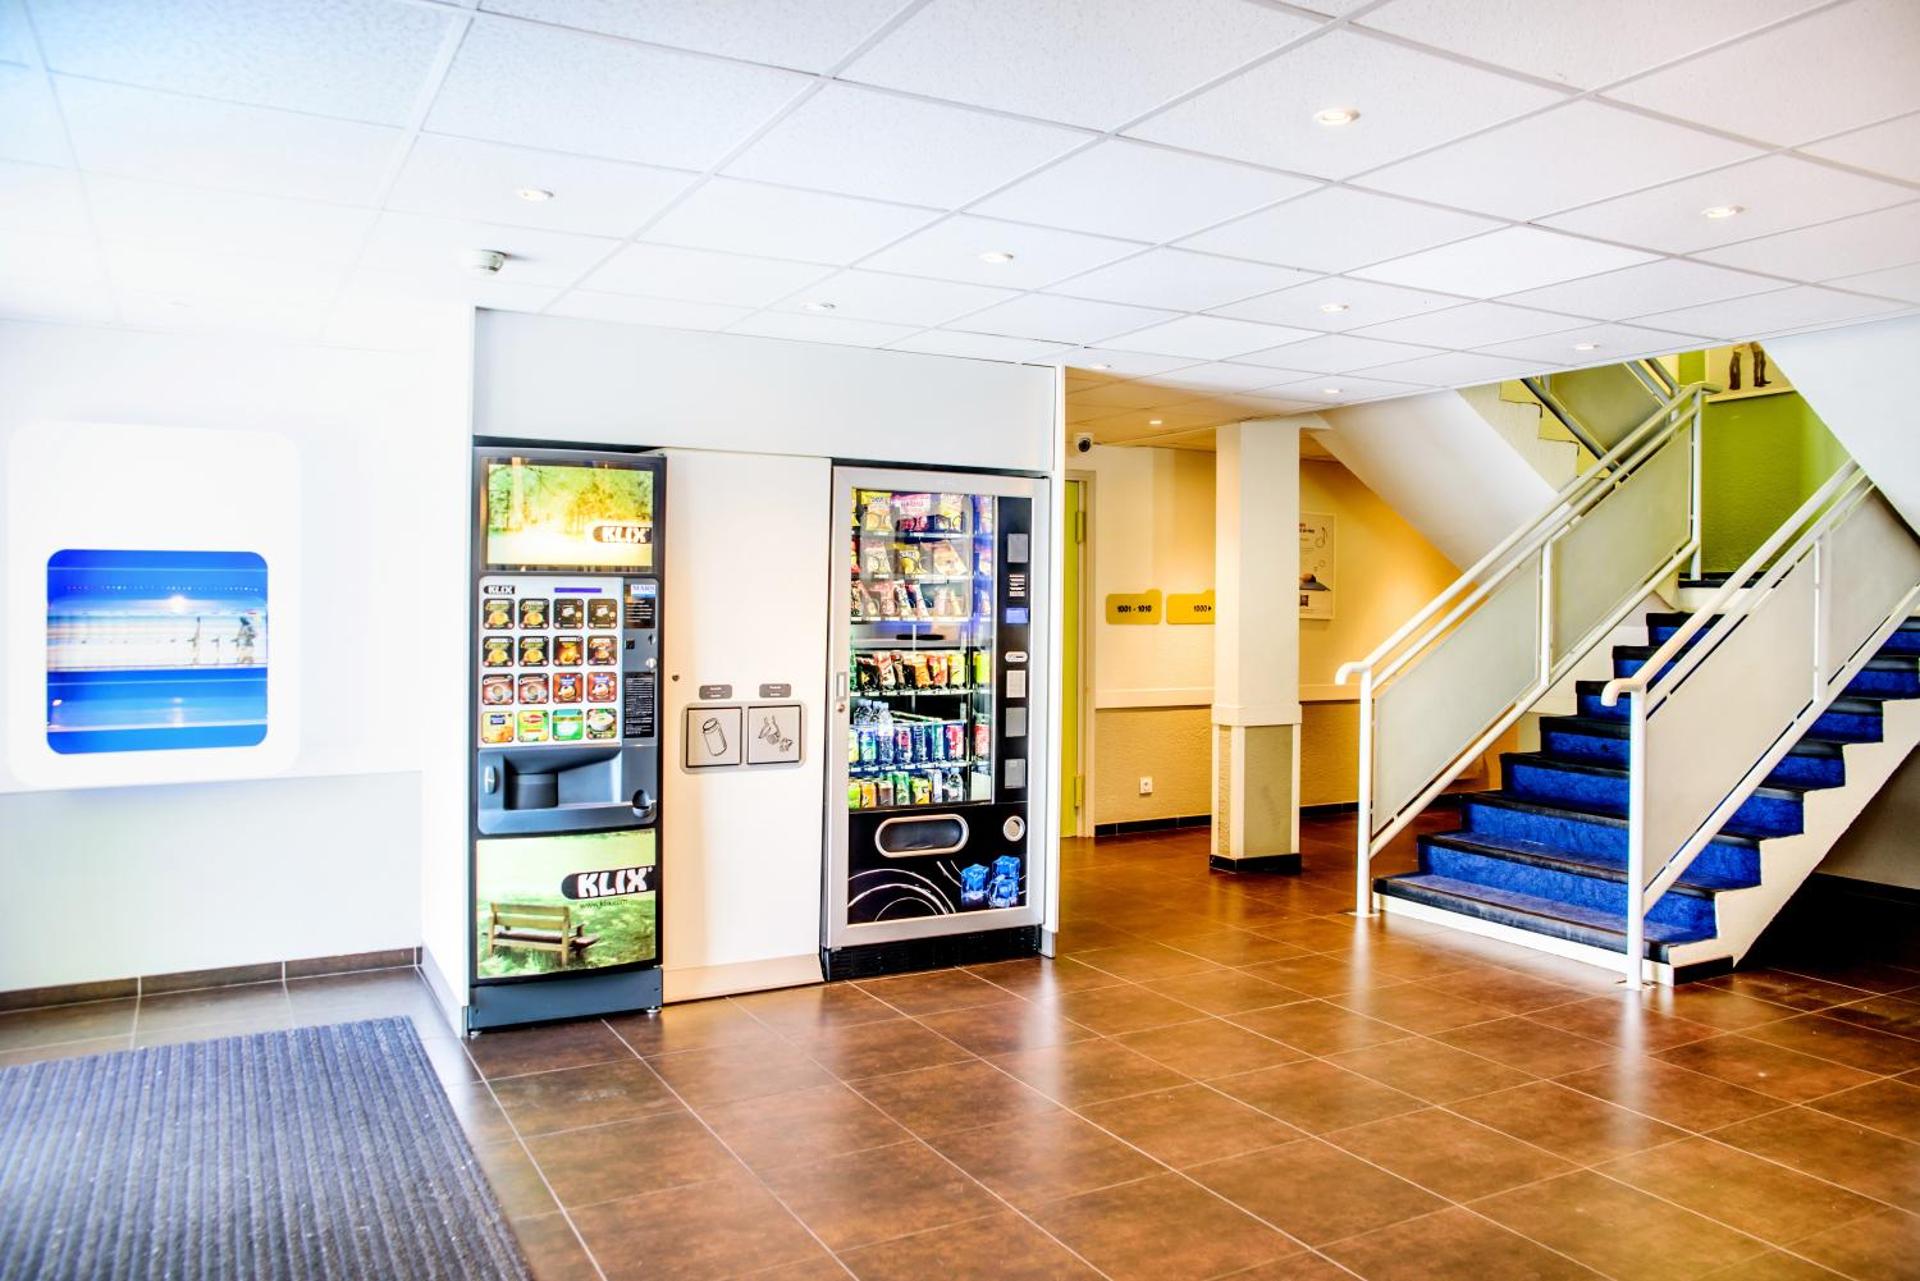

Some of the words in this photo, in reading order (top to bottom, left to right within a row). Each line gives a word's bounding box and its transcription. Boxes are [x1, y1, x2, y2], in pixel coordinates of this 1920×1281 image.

[602, 526, 647, 544] KLIX
[488, 585, 512, 594] KLIX
[1117, 604, 1131, 613] 1001
[1138, 604, 1152, 613] 1010
[577, 867, 648, 899] KLIX
